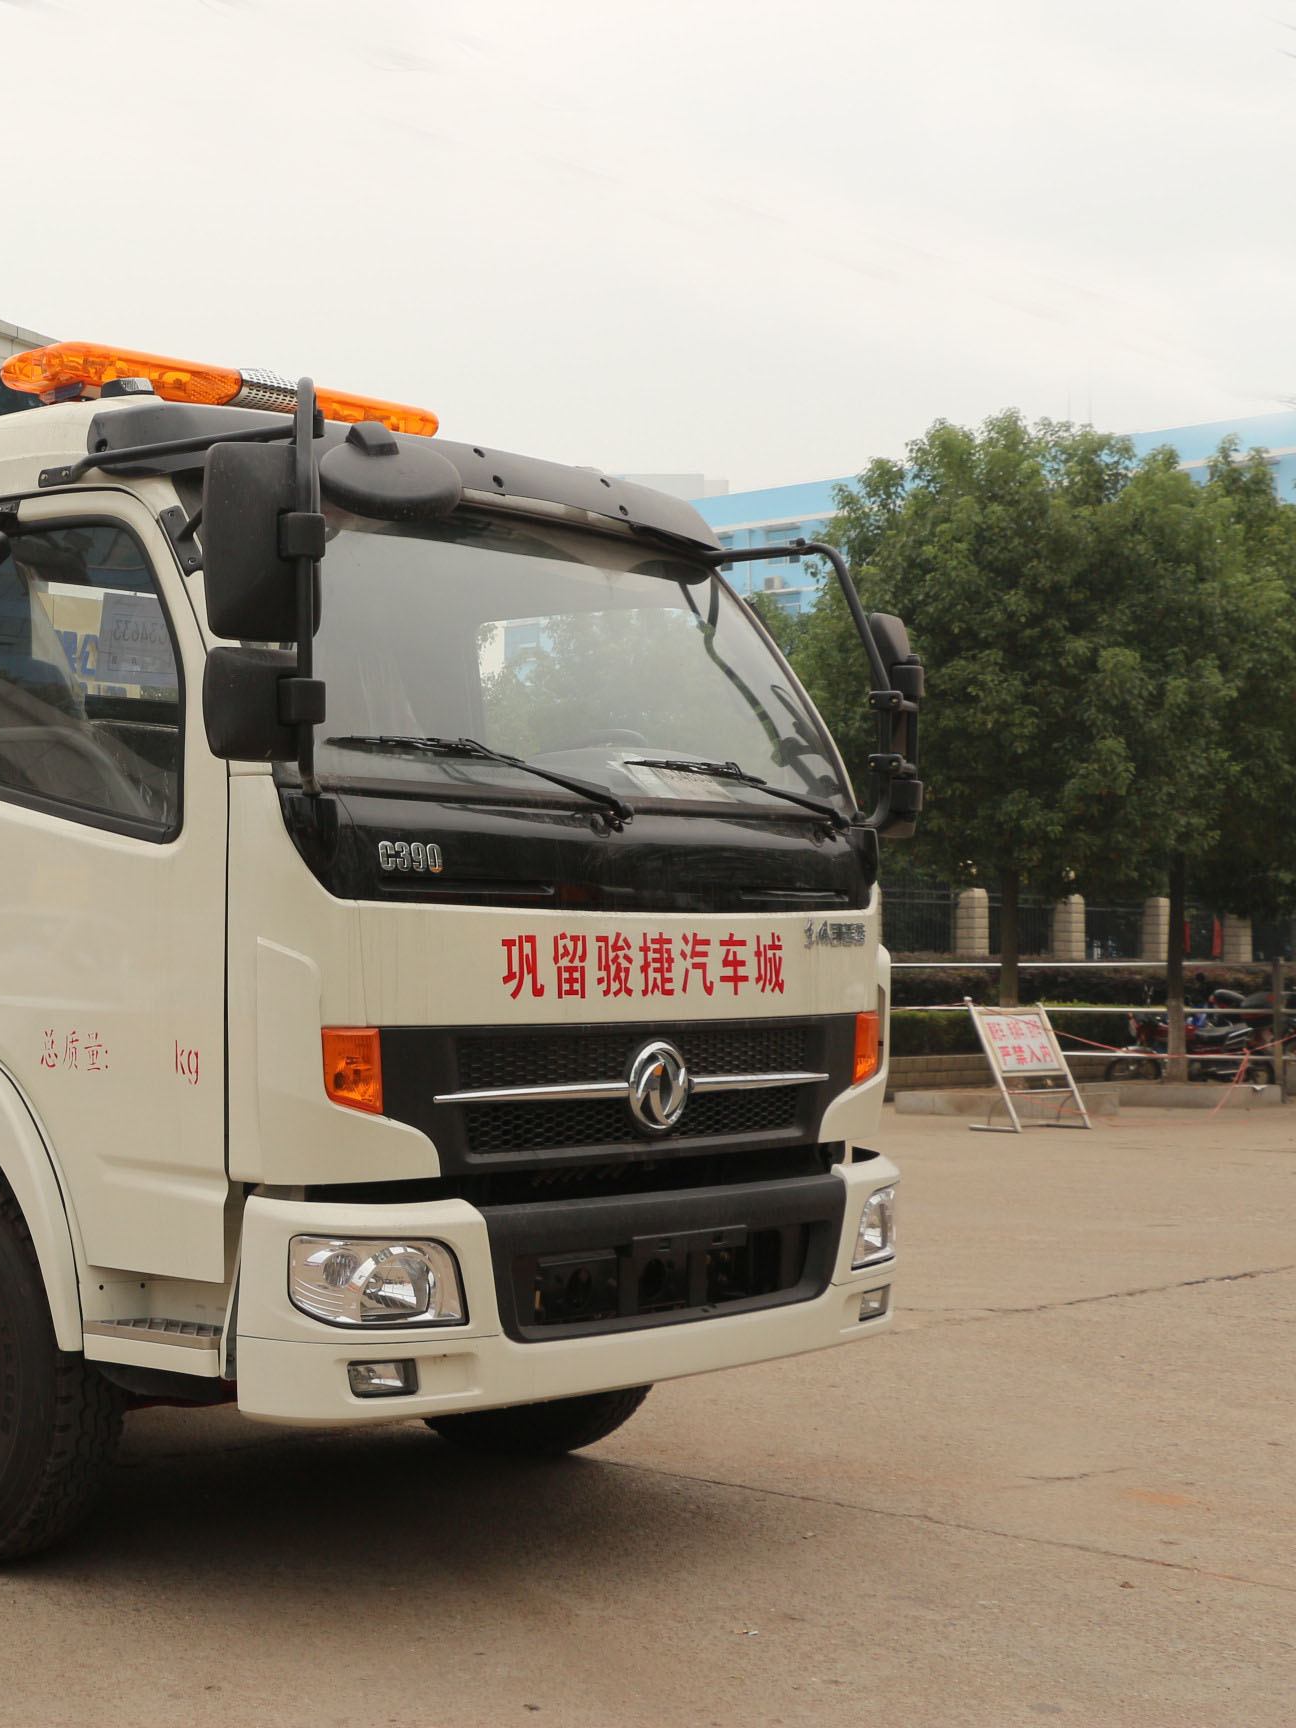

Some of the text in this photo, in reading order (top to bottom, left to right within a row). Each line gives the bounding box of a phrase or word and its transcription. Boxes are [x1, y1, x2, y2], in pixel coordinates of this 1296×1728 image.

[378, 841, 443, 873] C390
[501, 931, 785, 1000] 巩留骏捷汽车城
[175, 1039, 200, 1086] kg
